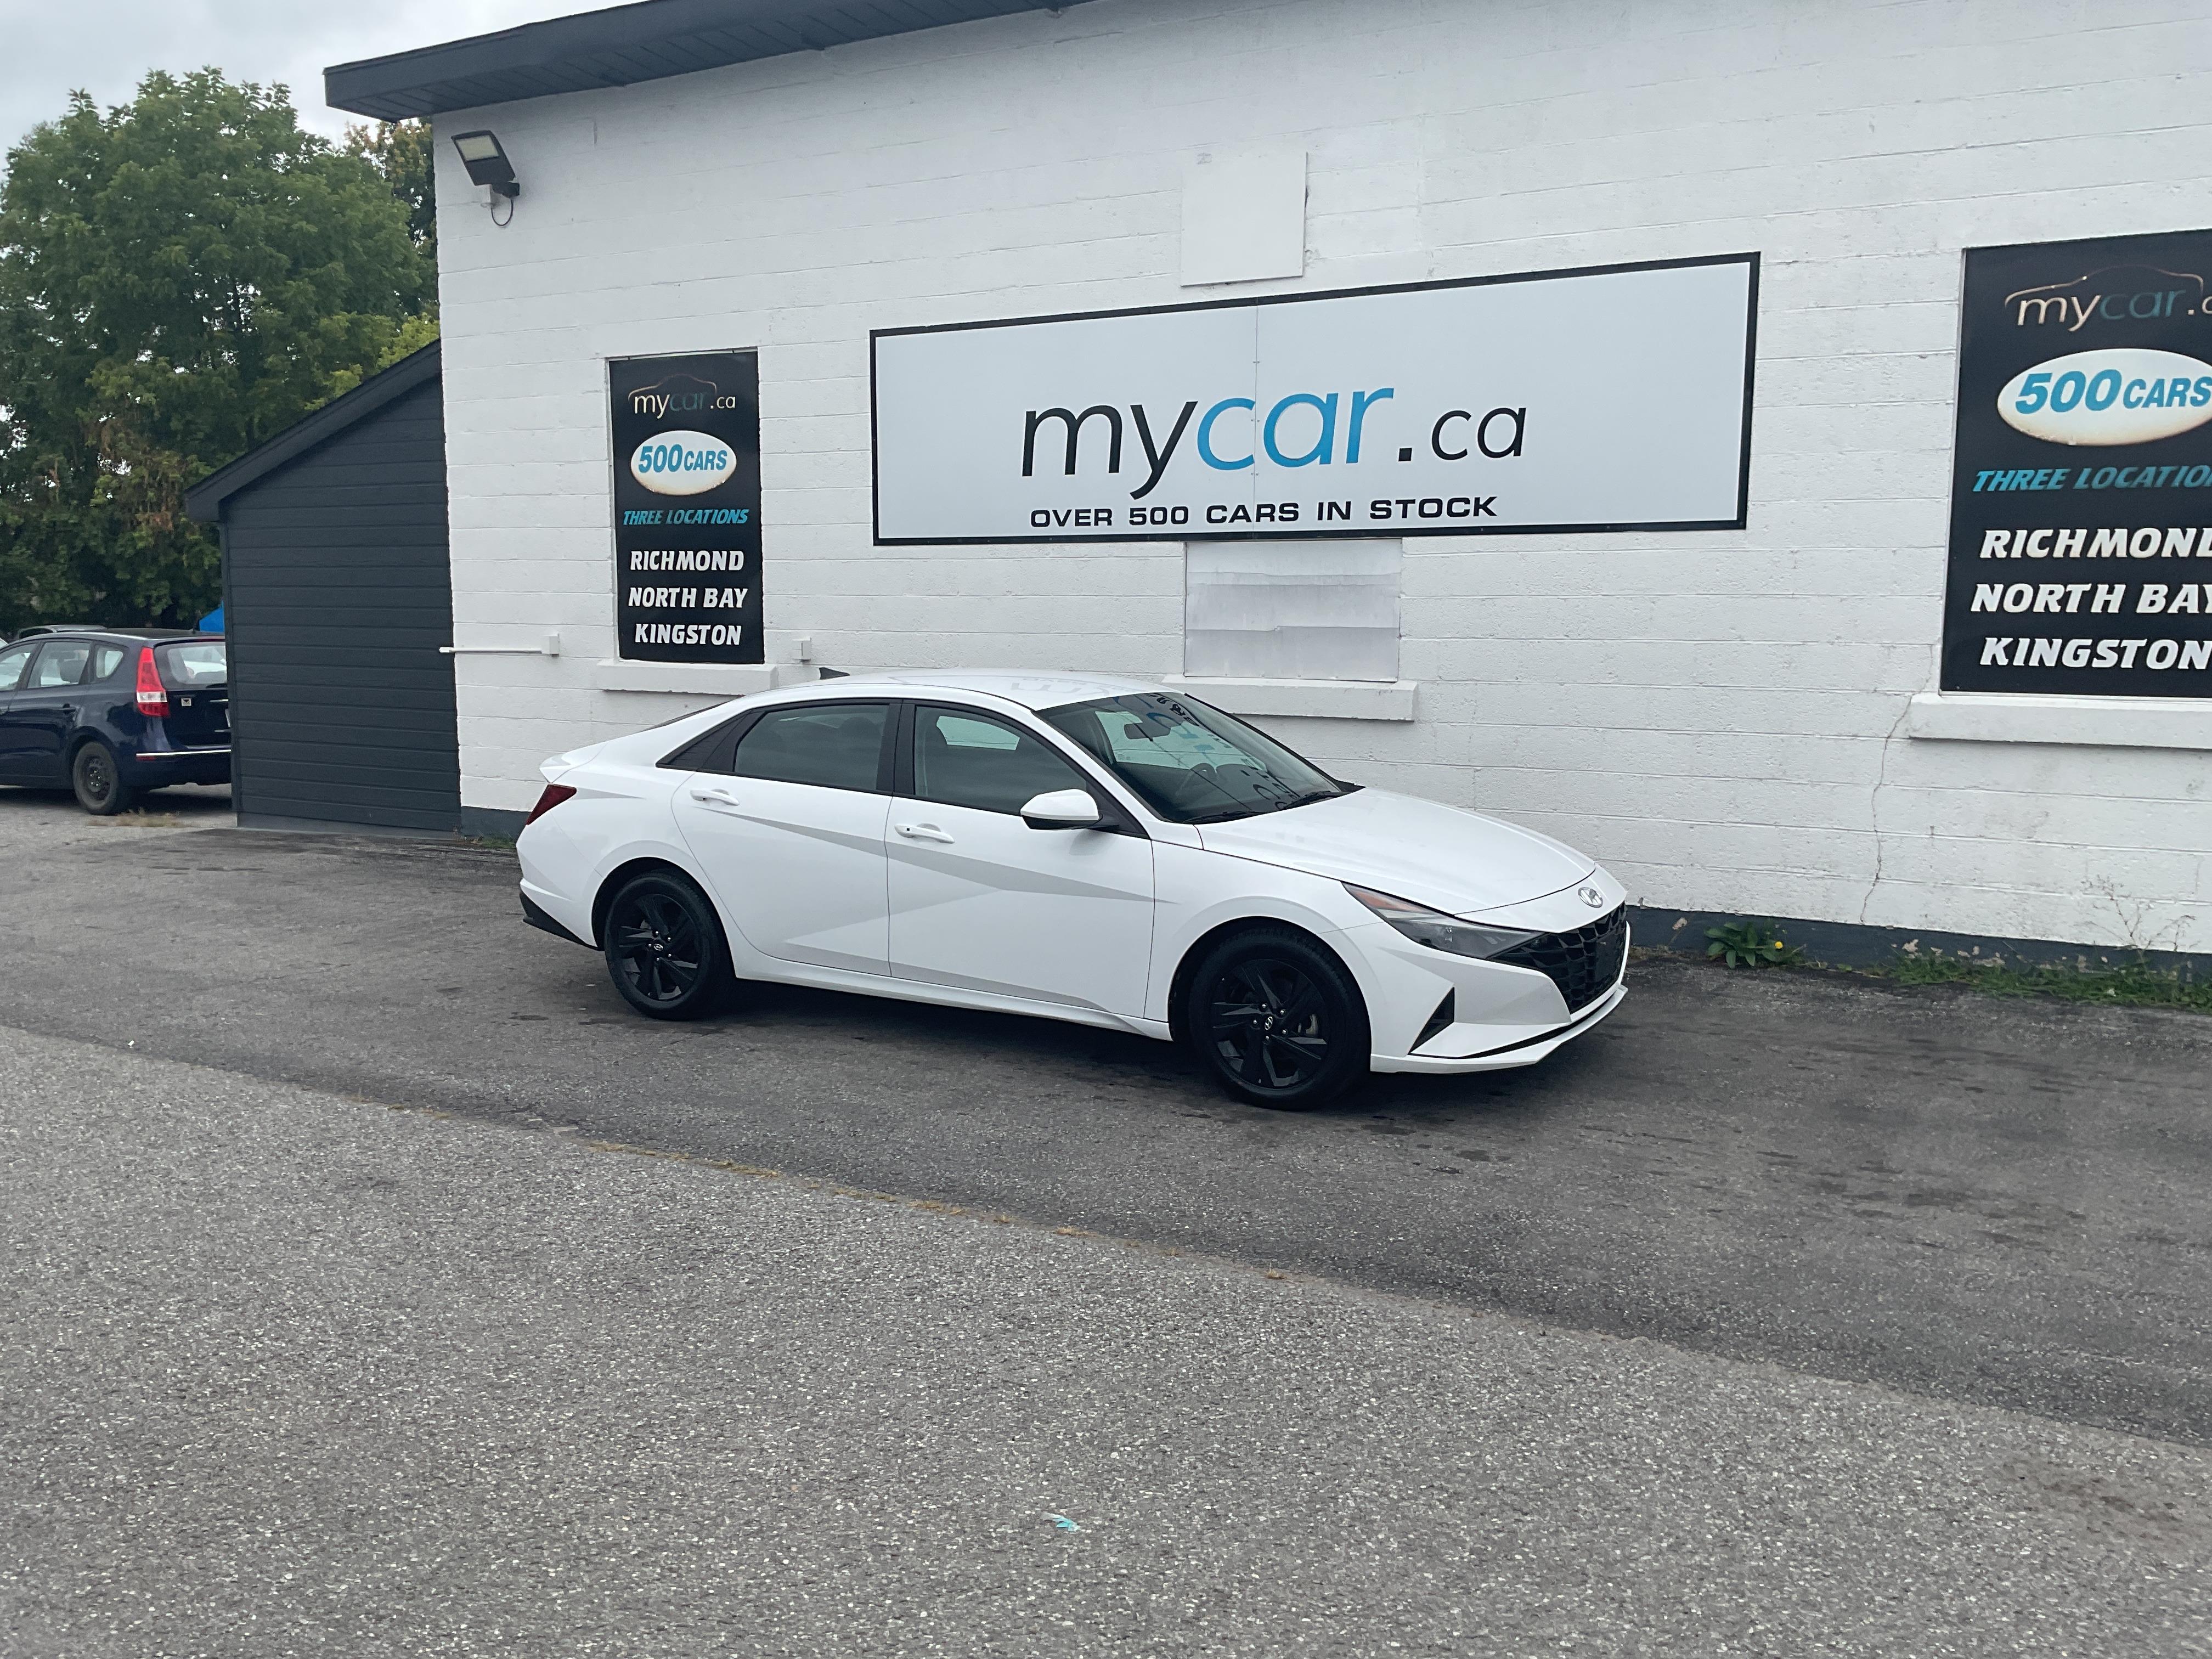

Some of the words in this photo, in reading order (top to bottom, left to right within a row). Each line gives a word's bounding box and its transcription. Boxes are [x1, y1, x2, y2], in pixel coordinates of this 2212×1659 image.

[1022, 388, 1527, 500] mycar.ca
[1972, 469, 2071, 492] THREE
[623, 510, 663, 525] THREE
[665, 509, 749, 525] LOCATIONS
[1030, 509, 1113, 527] OVER
[1129, 506, 1189, 526] 500
[1206, 503, 1300, 523] CARS
[1317, 501, 1351, 521] IN
[1369, 496, 1498, 519] STOCK
[630, 551, 744, 572] RICHMOND
[628, 587, 697, 608] NORTH
[703, 588, 748, 608] BAY
[1971, 583, 2126, 613] NORTH
[635, 623, 742, 646] KINGSTON
[1979, 637, 2212, 670] KINGSTON
